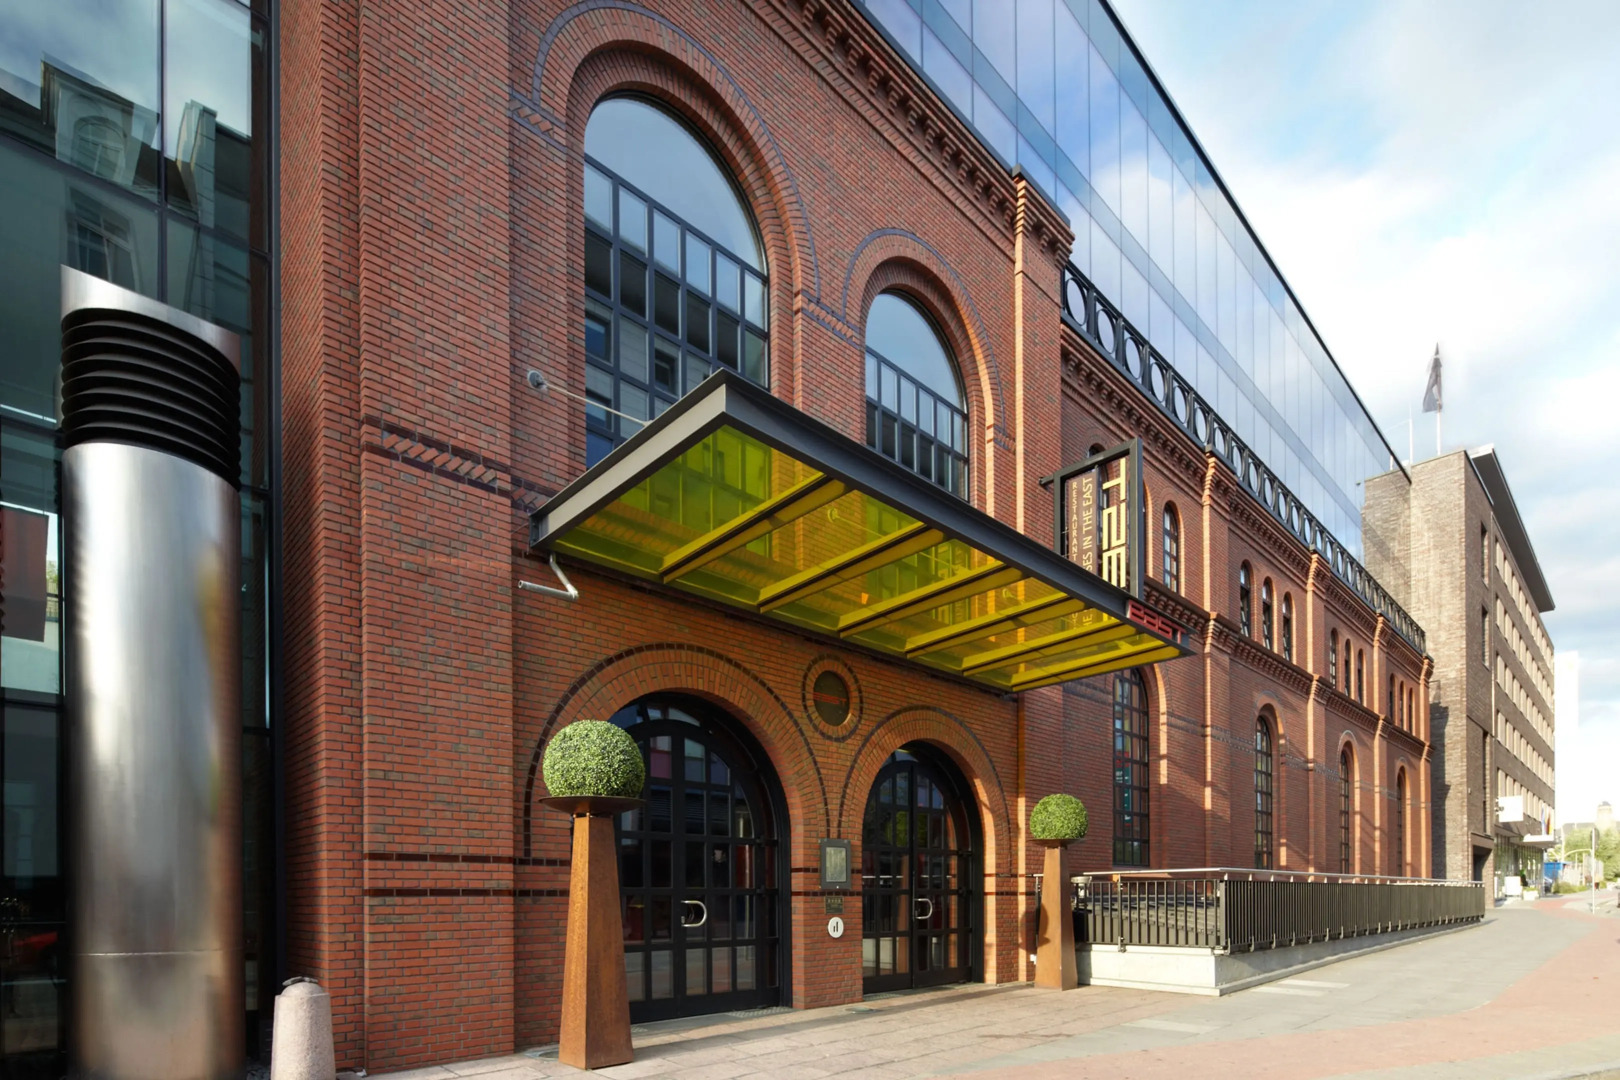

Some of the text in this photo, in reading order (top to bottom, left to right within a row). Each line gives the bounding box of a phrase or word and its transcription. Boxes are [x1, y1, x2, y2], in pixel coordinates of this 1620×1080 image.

[1082, 477, 1093, 507] EAST
[1082, 507, 1093, 535] THE
[1082, 535, 1093, 550] IN
